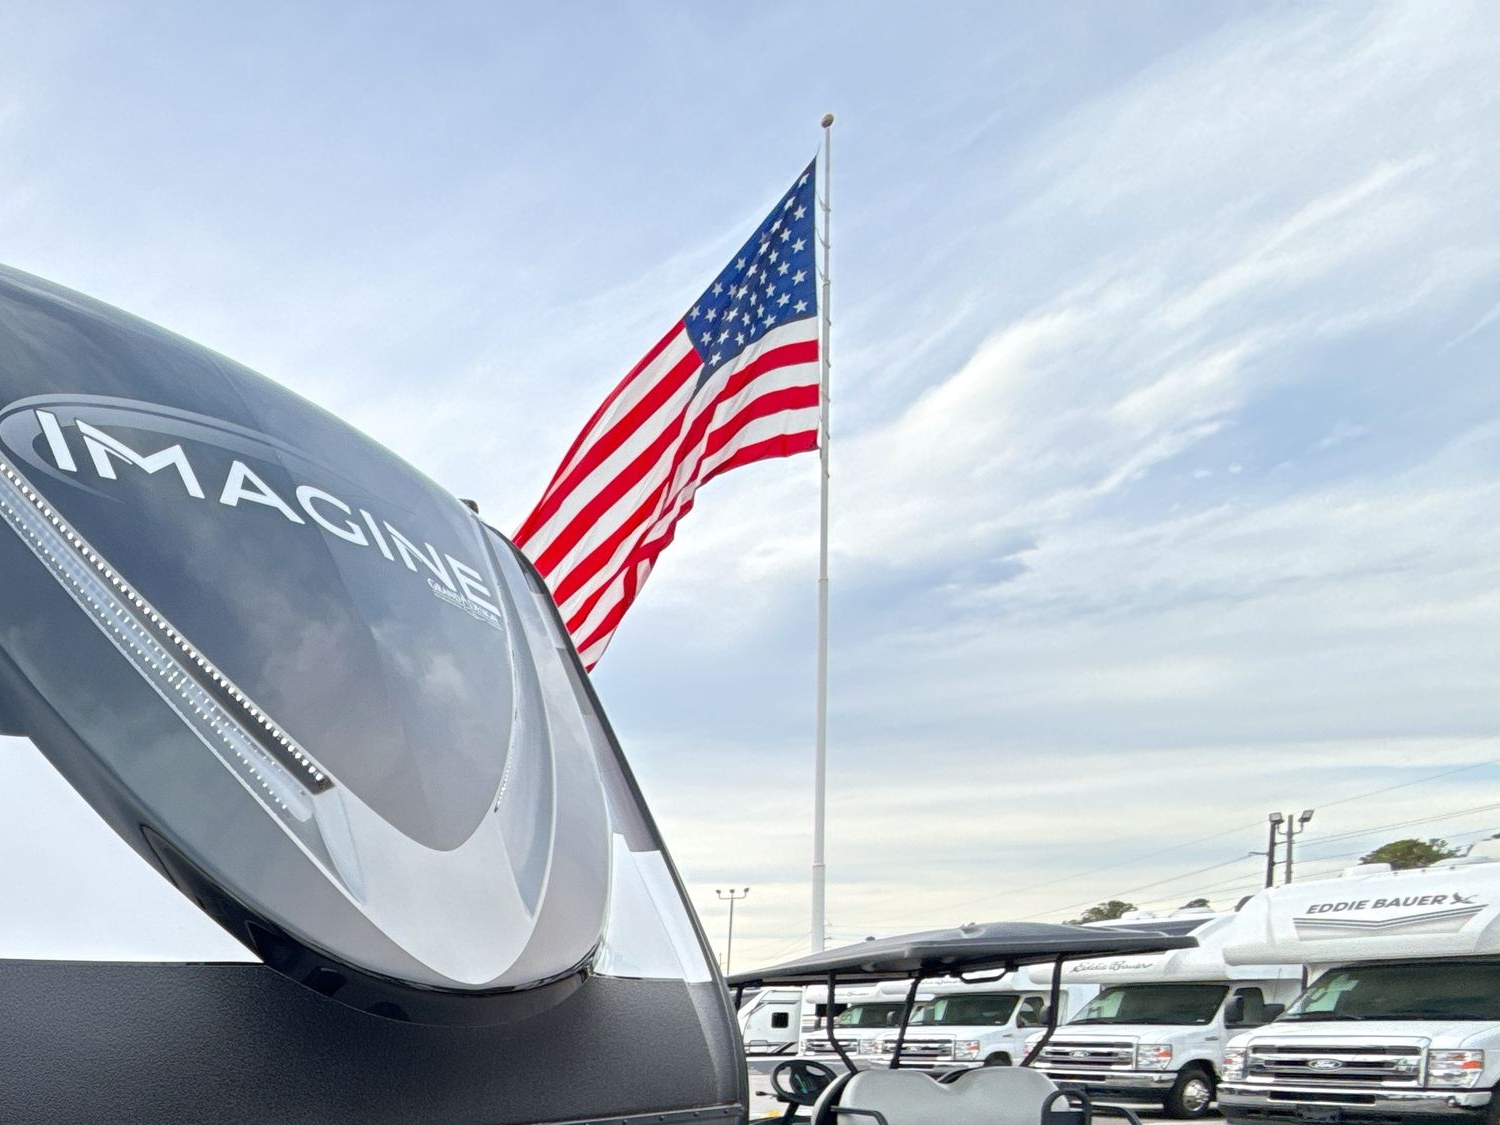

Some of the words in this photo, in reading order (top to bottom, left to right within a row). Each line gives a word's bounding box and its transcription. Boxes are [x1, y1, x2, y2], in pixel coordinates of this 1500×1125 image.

[34, 408, 502, 619] IMAGINE
[1306, 900, 1370, 915] EDDIE
[1371, 894, 1449, 910] BAUER
